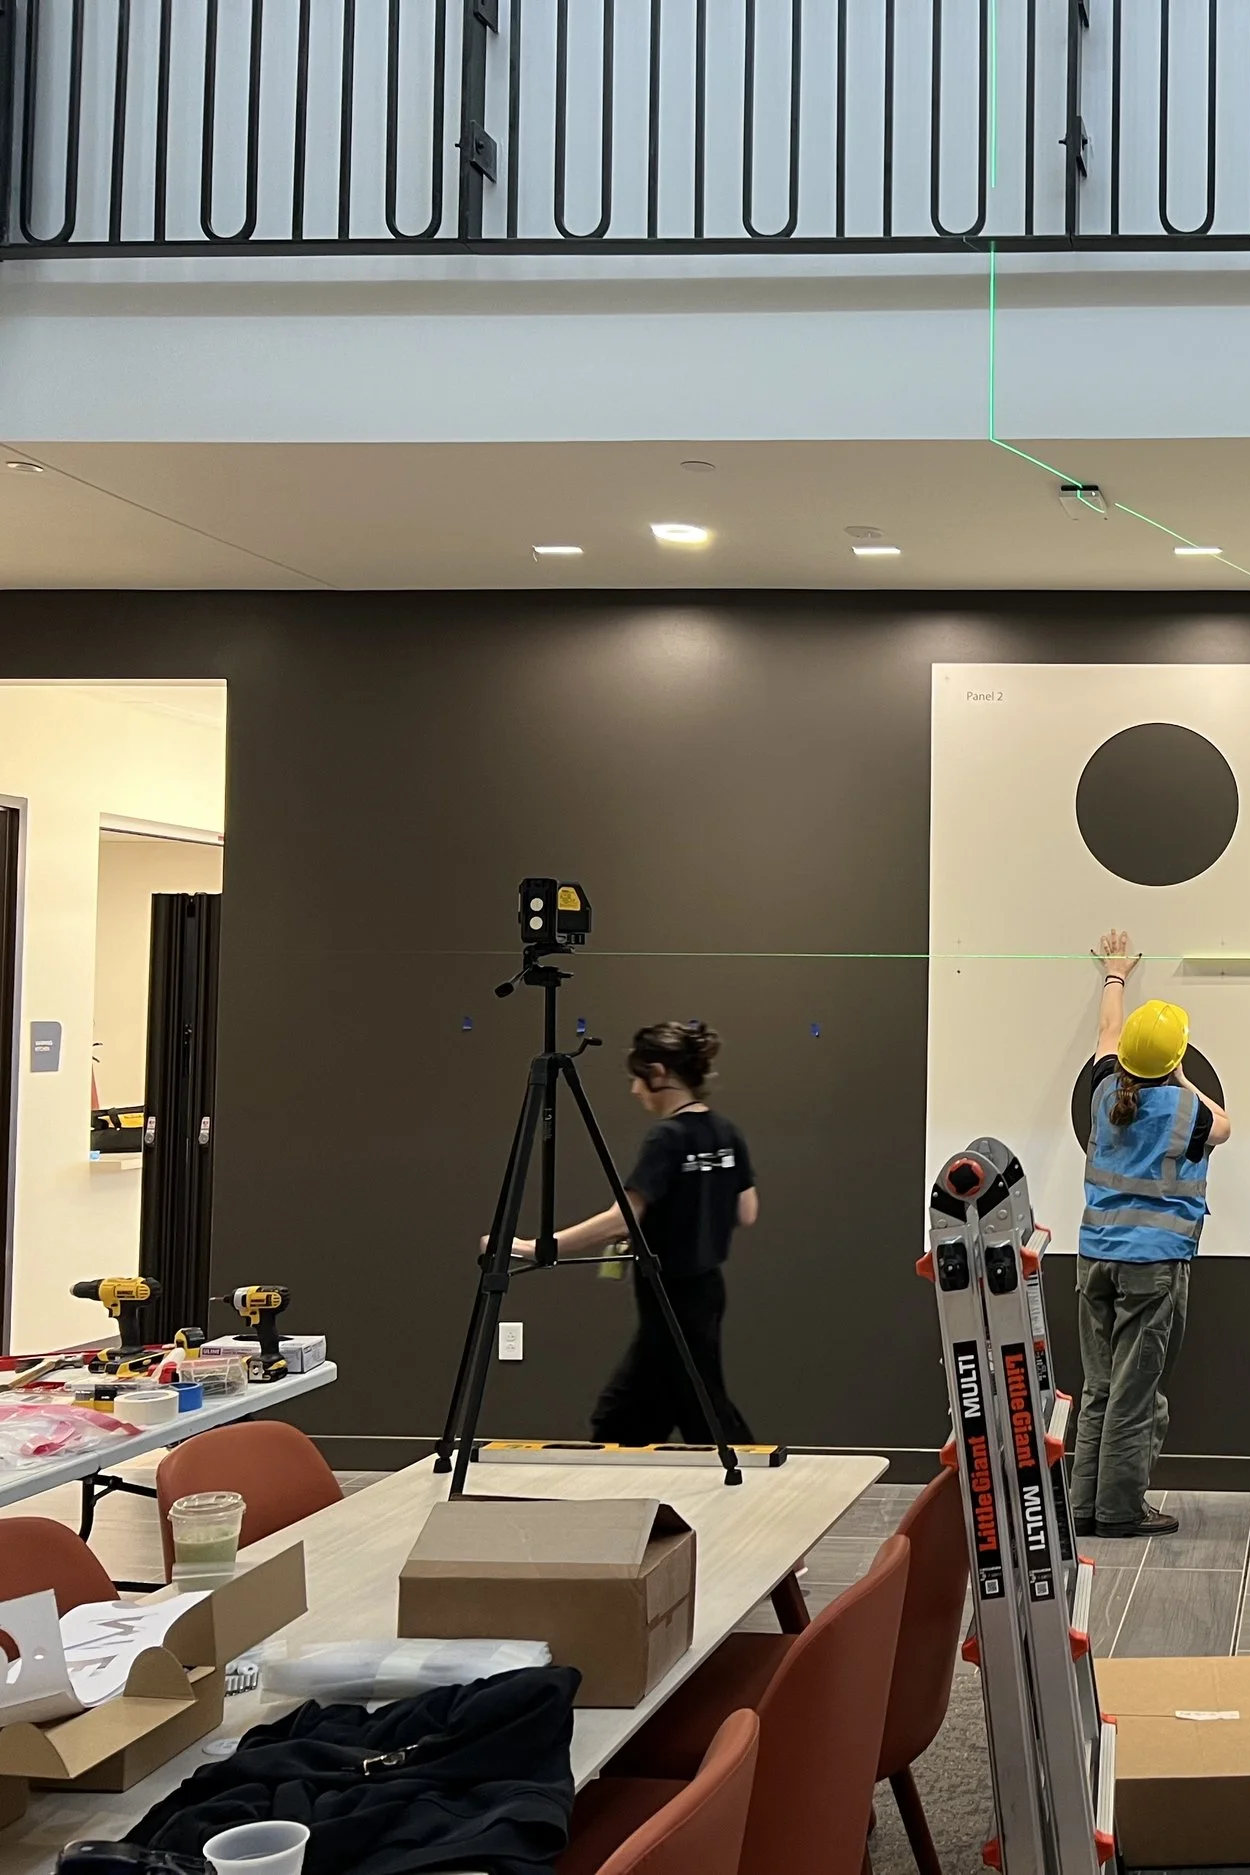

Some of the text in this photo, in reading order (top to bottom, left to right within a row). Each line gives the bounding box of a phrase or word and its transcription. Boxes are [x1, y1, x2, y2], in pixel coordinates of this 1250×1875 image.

[966, 691, 1003, 701] Panel 2
[958, 1354, 981, 1418] MULTI
[1022, 1485, 1046, 1551] MULTI
